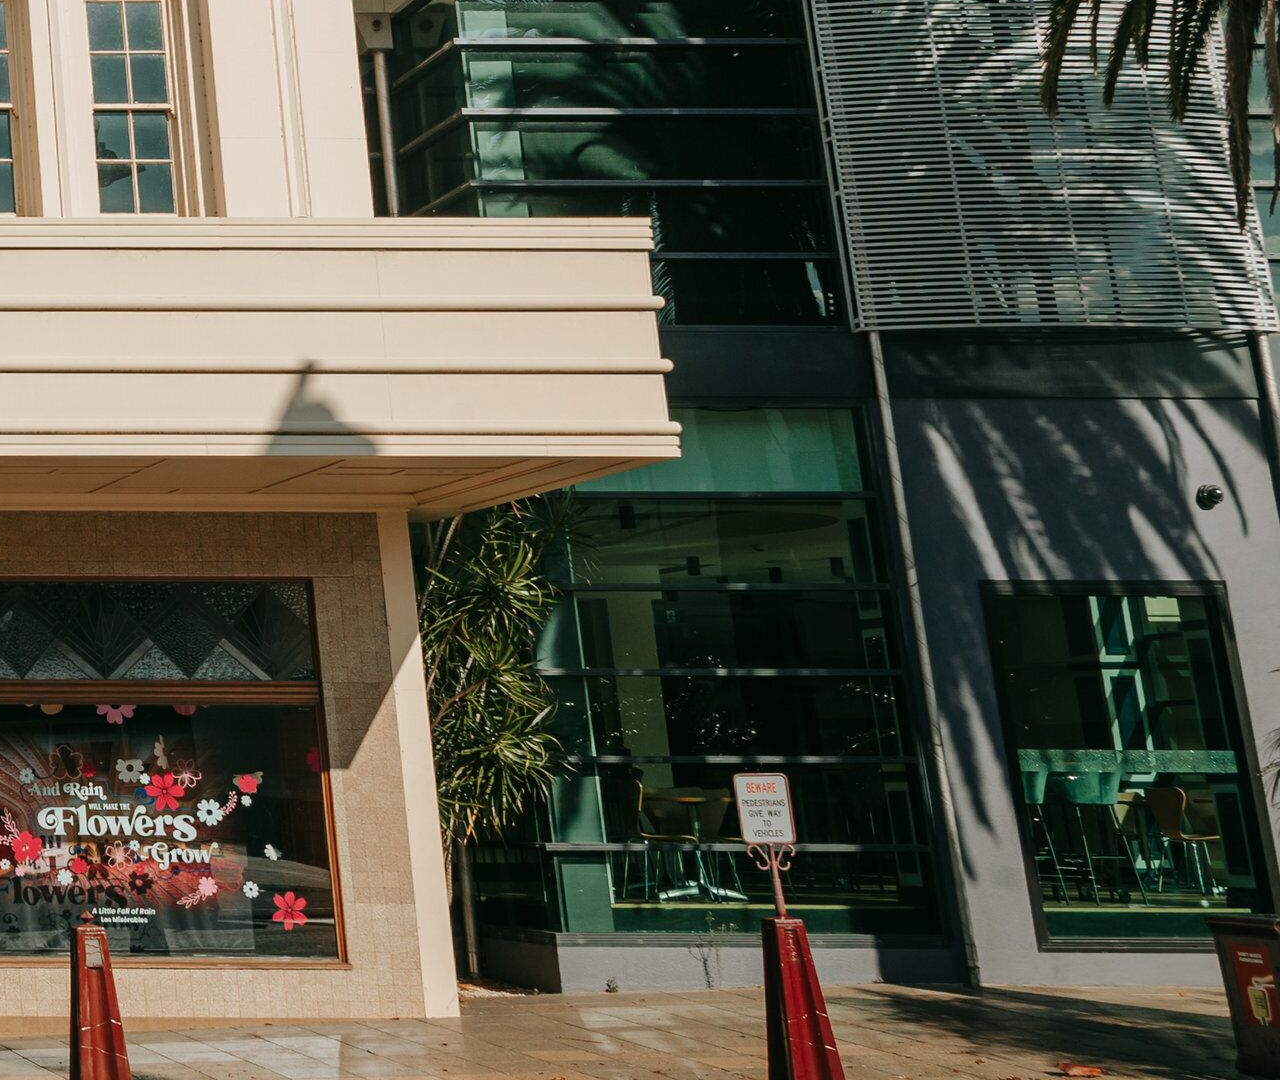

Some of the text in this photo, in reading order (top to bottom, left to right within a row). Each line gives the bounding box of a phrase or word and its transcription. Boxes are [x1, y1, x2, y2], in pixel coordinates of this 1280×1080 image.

[28, 781, 107, 801] And Rain
[745, 782, 777, 793] BEWARE
[88, 803, 131, 811] WILL MAKE THE
[742, 799, 786, 807] PEDESTRIANS
[749, 809, 782, 818] GIVE WAY
[37, 804, 198, 842] Flowers
[762, 819, 772, 827] TO
[752, 829, 784, 838] VEHICLES
[141, 841, 219, 871] Grow
[92, 907, 98, 915] A
